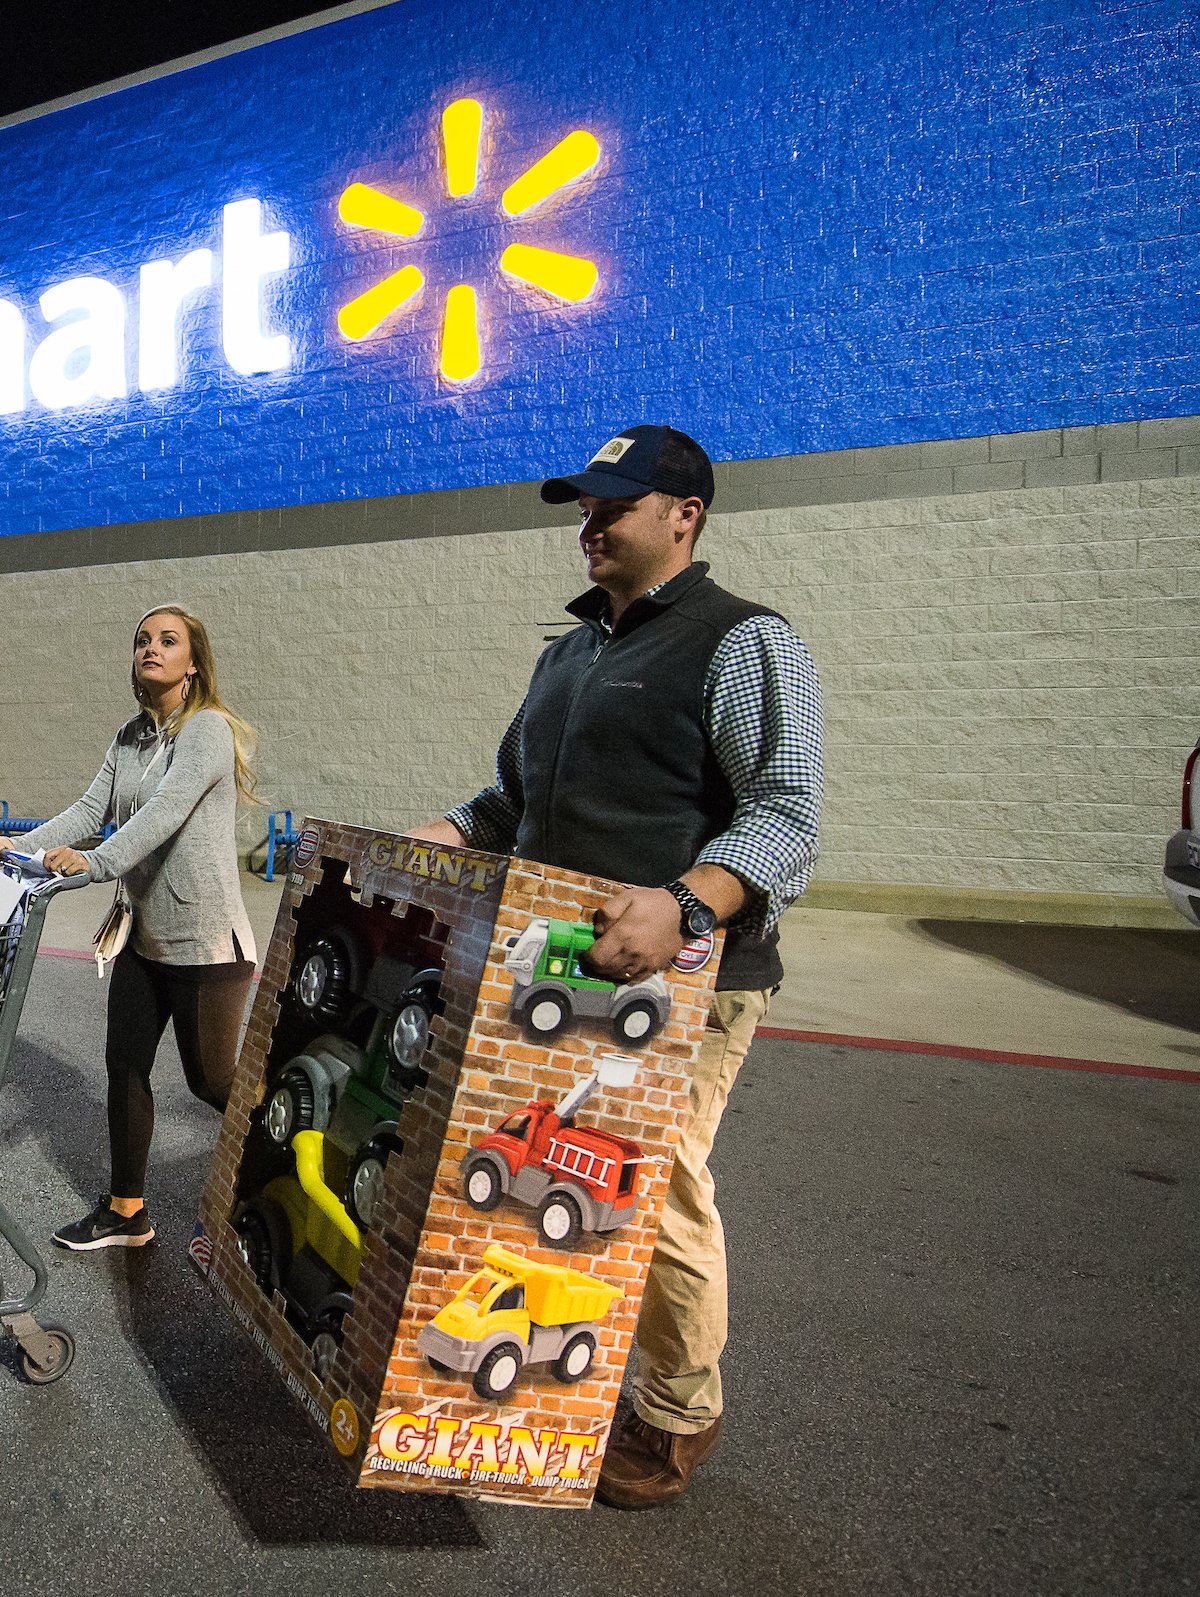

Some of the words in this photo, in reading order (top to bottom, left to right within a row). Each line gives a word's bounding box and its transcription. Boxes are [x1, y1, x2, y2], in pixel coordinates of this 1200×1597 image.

[369, 838, 498, 892] GIANT
[233, 1300, 251, 1331] TRUCK
[253, 1327, 266, 1350] FIRE
[265, 1342, 285, 1375] TRUCK
[287, 1373, 308, 1401] DUMP
[306, 1394, 329, 1433] TRUCK
[335, 1408, 355, 1441] 2+
[378, 1411, 599, 1478] GIANT
[370, 1457, 427, 1476] RECYCLING
[427, 1464, 463, 1480] TRUCK
[494, 1471, 525, 1485] TRUCK
[531, 1475, 560, 1488] DUMP
[560, 1477, 591, 1489] TRUCK
